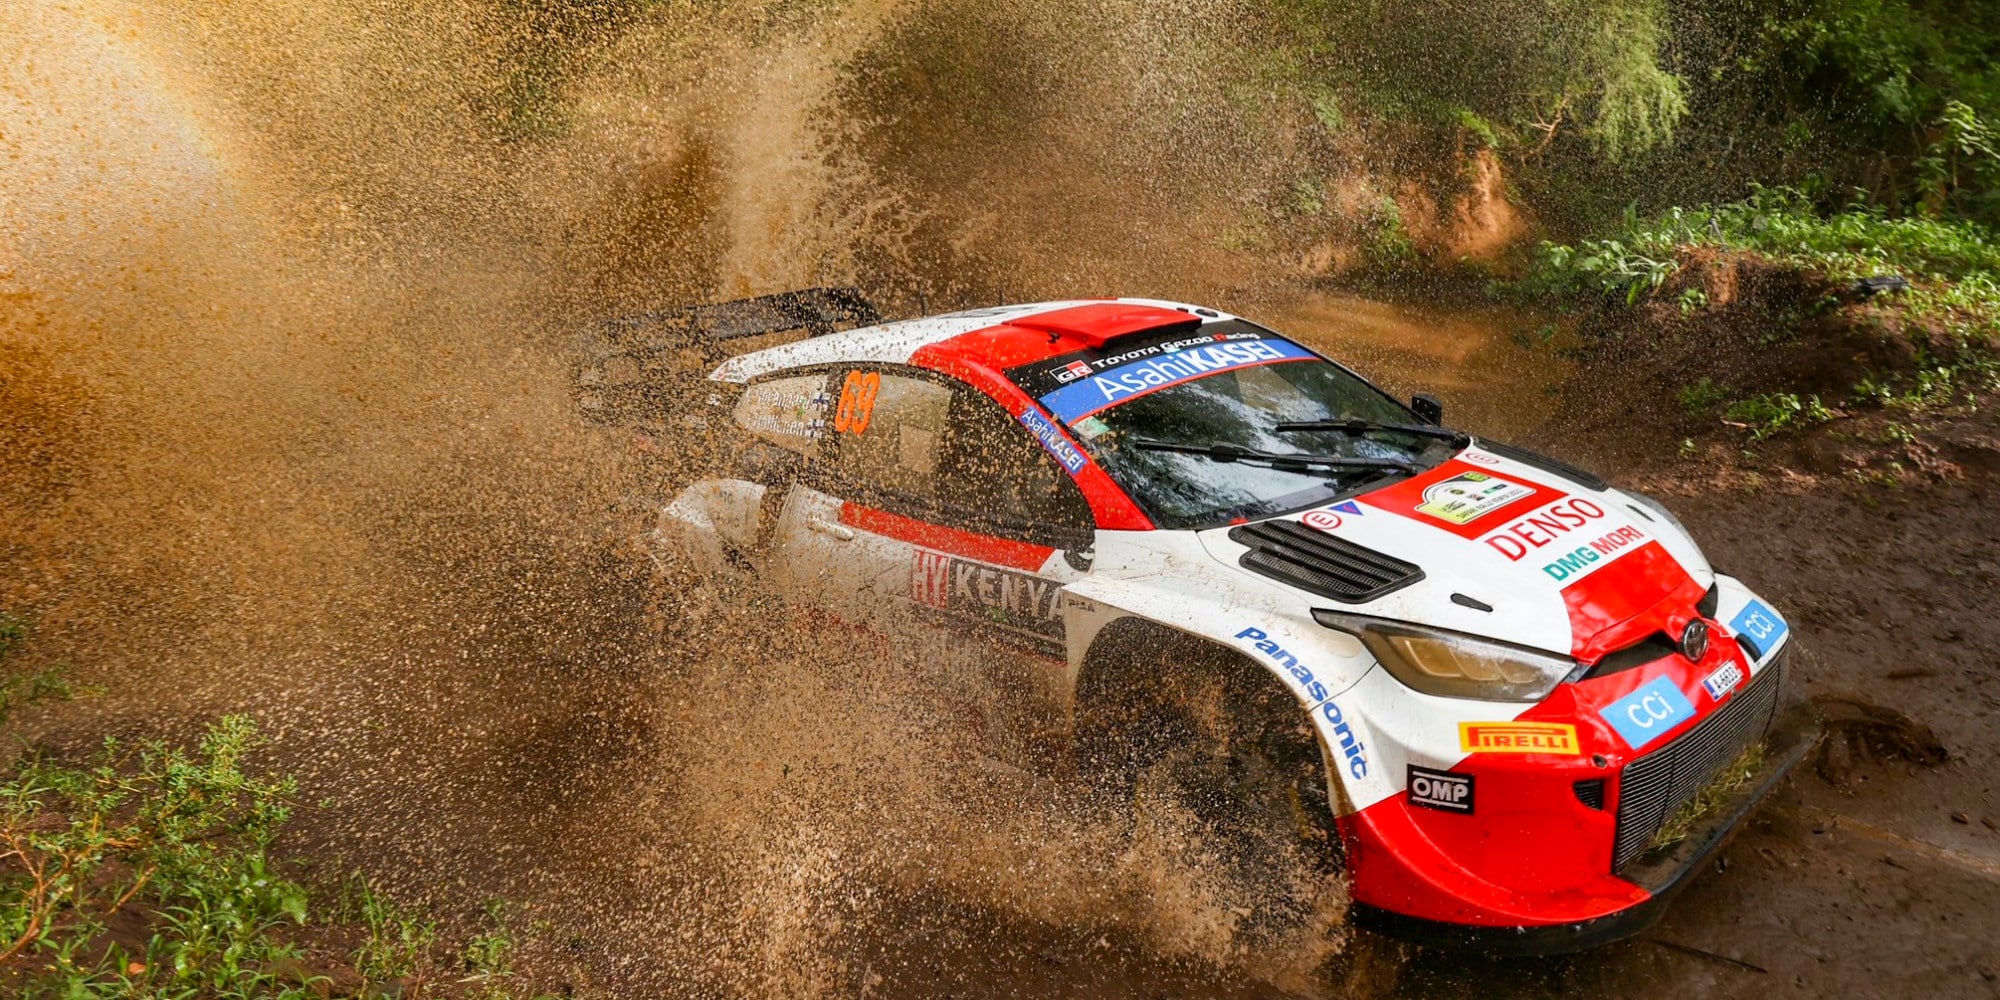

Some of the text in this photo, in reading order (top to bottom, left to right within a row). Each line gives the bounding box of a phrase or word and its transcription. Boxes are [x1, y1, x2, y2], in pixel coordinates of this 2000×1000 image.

[1057, 364, 1093, 382] GR
[1091, 346, 1160, 368] TOYOTA
[1213, 332, 1261, 342] Racing
[1095, 341, 1286, 400] AsahiKASEI
[835, 370, 881, 435] 69
[1021, 409, 1083, 471] AsahiKASEI
[1484, 499, 1604, 561] DENSO
[1542, 525, 1644, 581] DMG MORI
[1234, 627, 1367, 780] Panasonic
[1467, 726, 1568, 749] PIRELLI
[1412, 777, 1468, 802] OMP
